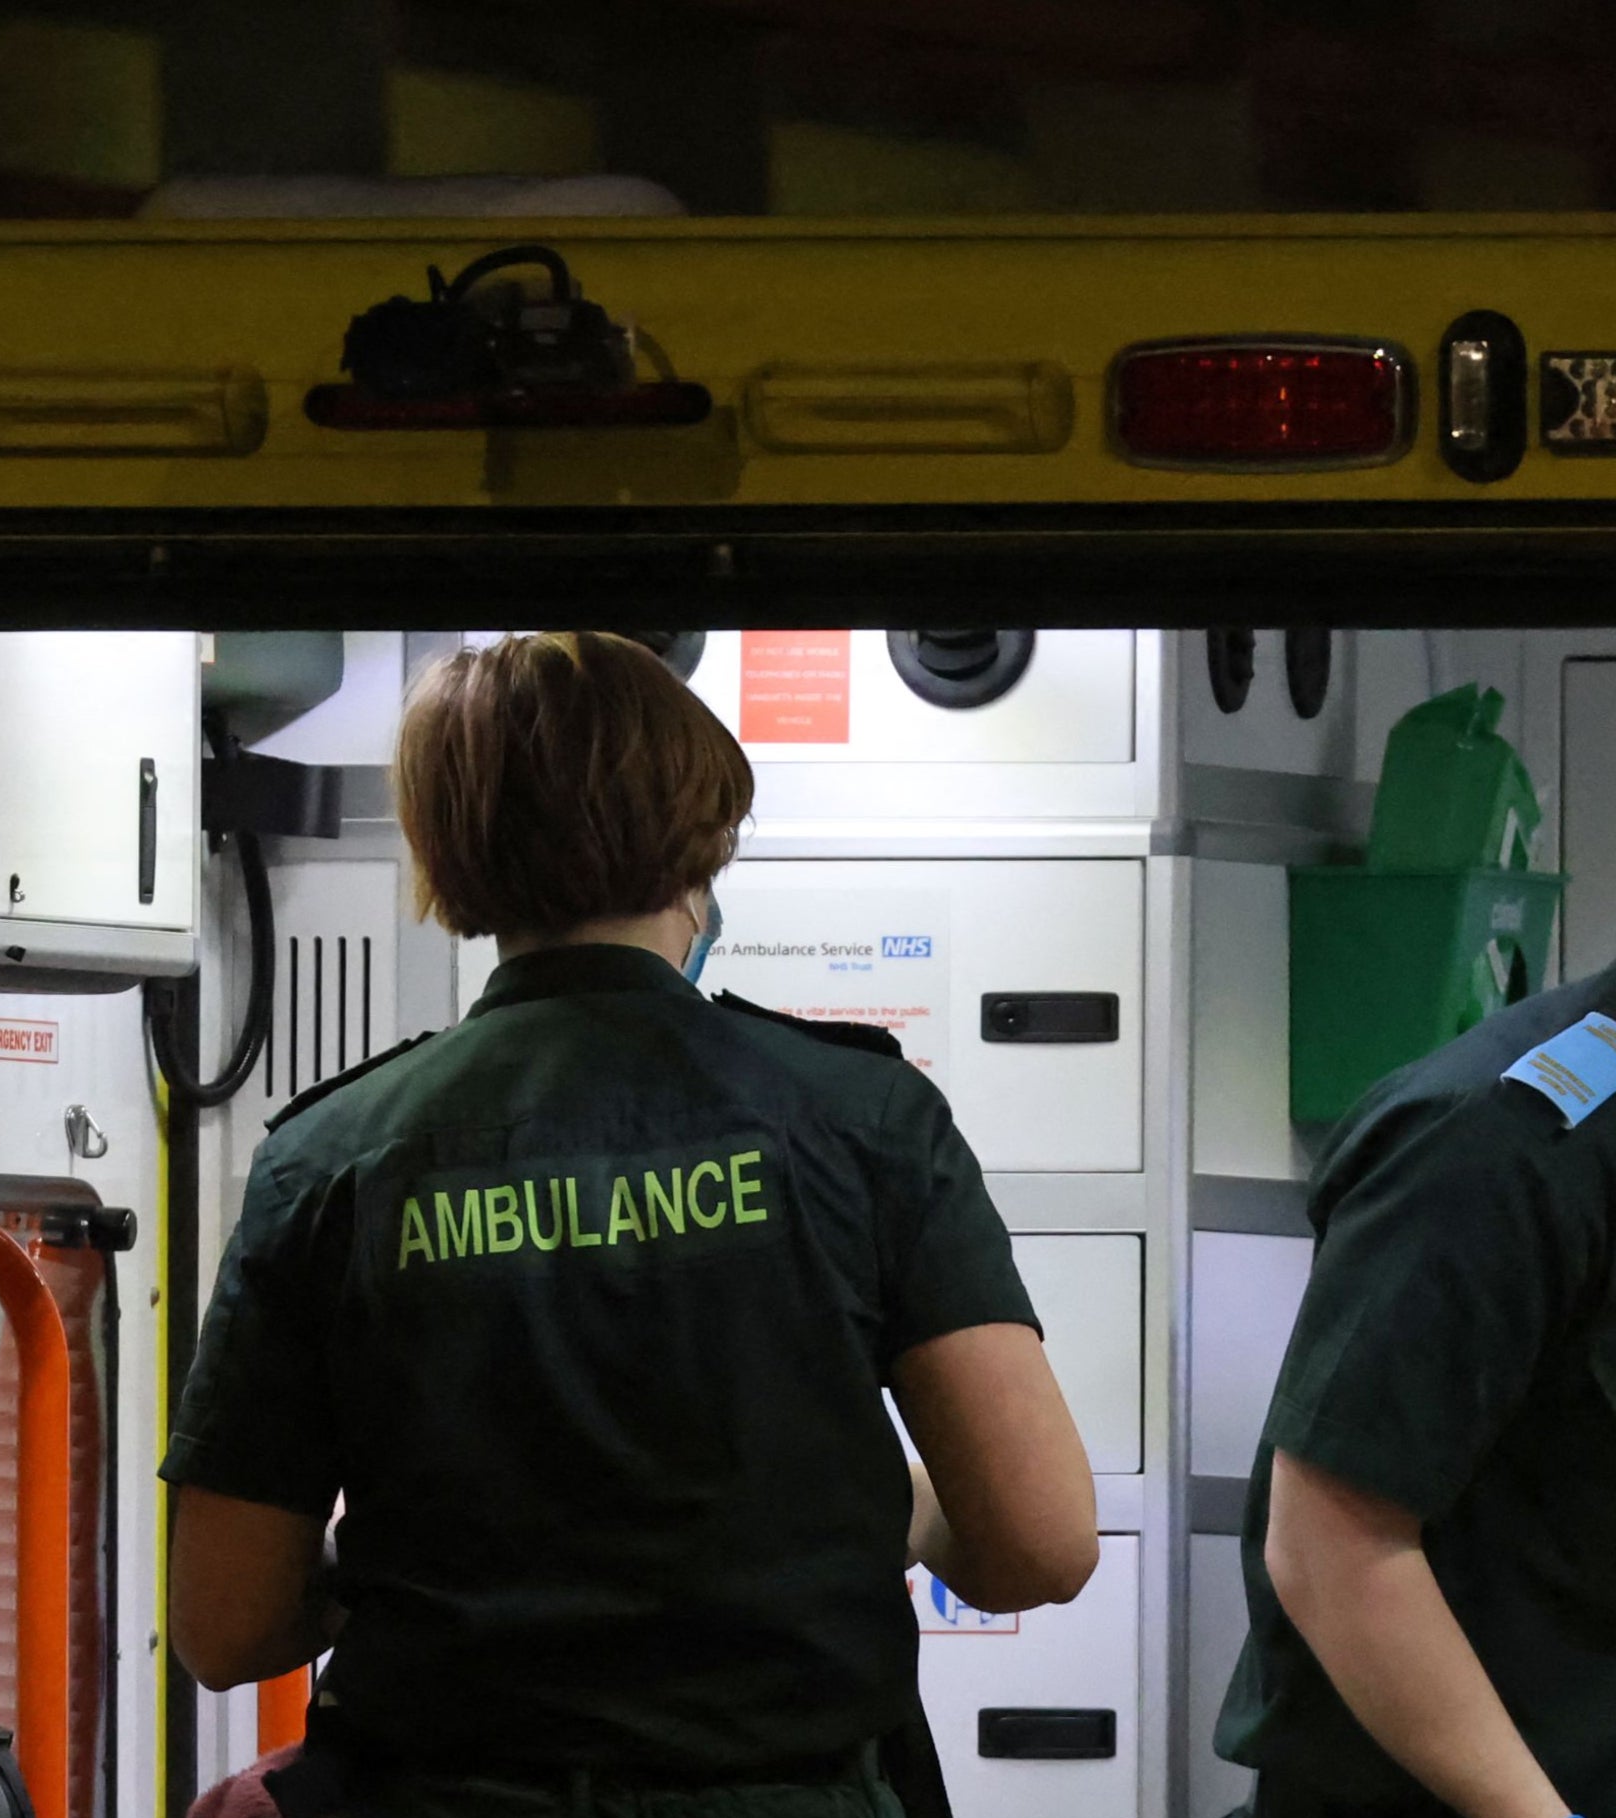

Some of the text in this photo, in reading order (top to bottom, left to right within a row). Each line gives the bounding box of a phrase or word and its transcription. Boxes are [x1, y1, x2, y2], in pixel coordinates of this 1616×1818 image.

[731, 942, 816, 956] Ambulance
[821, 942, 873, 956] Service
[882, 936, 931, 957] NHS
[33, 1031, 54, 1053] EXIT
[397, 1149, 769, 1271] AMBULANCE
